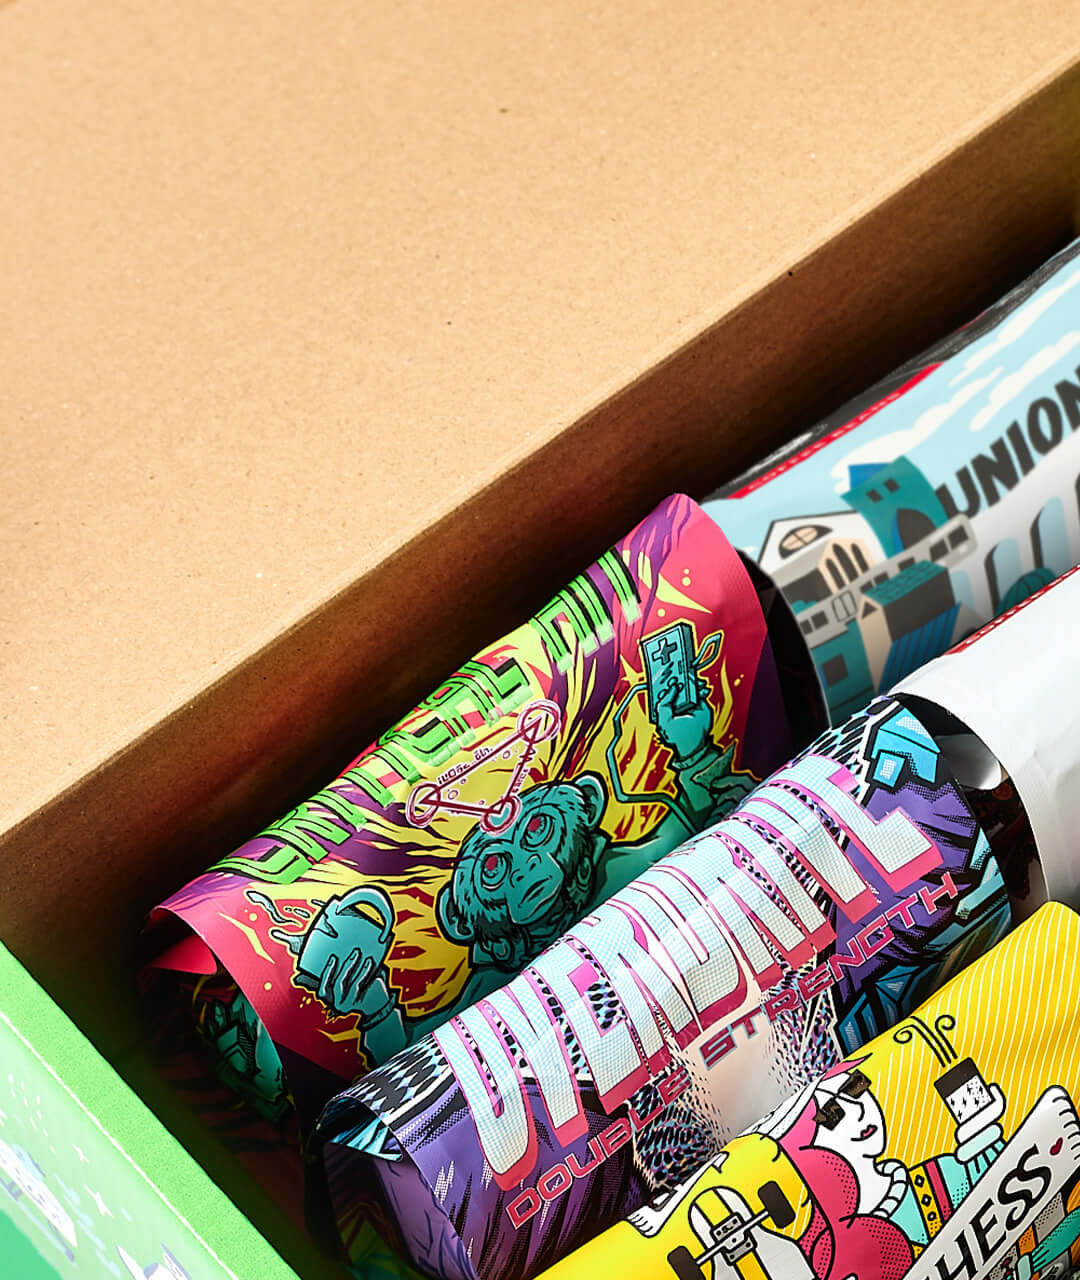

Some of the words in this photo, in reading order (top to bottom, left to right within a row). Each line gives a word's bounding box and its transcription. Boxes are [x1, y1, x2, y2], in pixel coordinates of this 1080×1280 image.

[433, 755, 943, 1192] OVERDRIVE
[507, 1064, 690, 1229] DOUBLE
[700, 871, 958, 1069] STRENGTH
